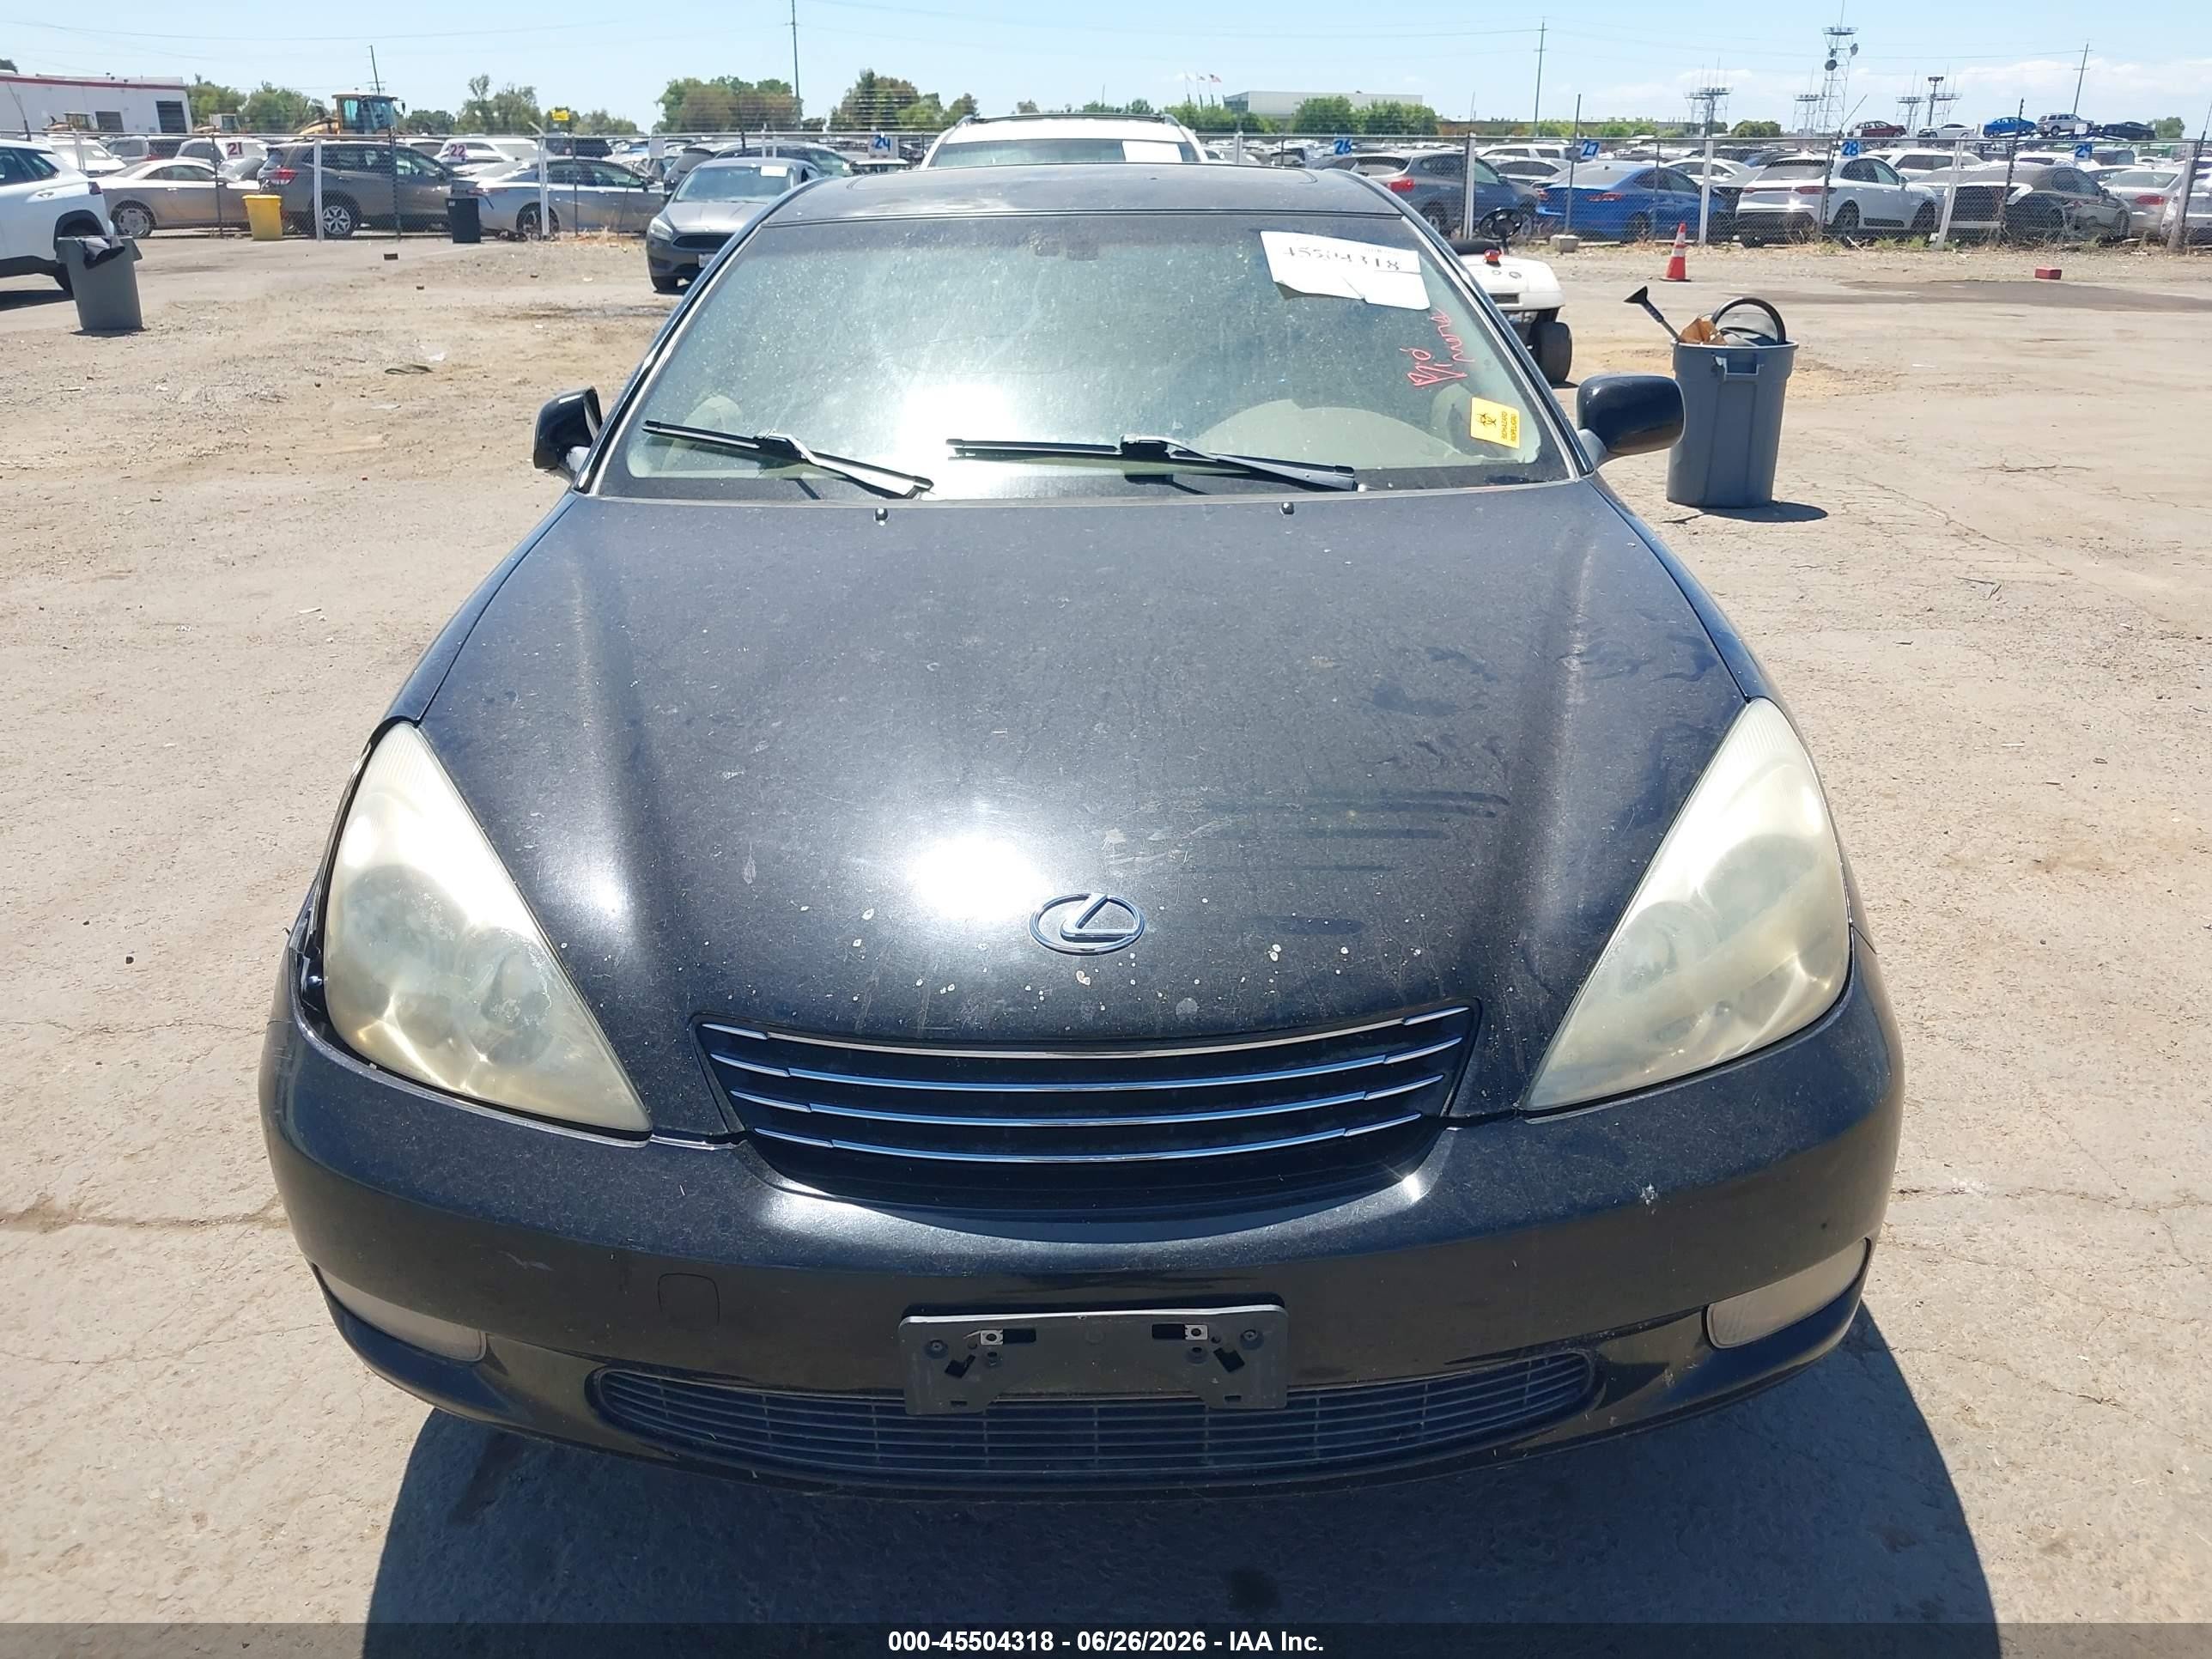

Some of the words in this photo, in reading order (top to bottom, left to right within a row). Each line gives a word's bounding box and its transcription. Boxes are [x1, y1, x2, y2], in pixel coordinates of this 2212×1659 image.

[227, 143, 243, 155] 21
[450, 143, 465, 157] 22
[874, 137, 890, 152] 24
[1334, 138, 1352, 155] 26
[1582, 140, 1599, 157] 27
[1842, 141, 1859, 156] 28
[2075, 143, 2093, 159] 29
